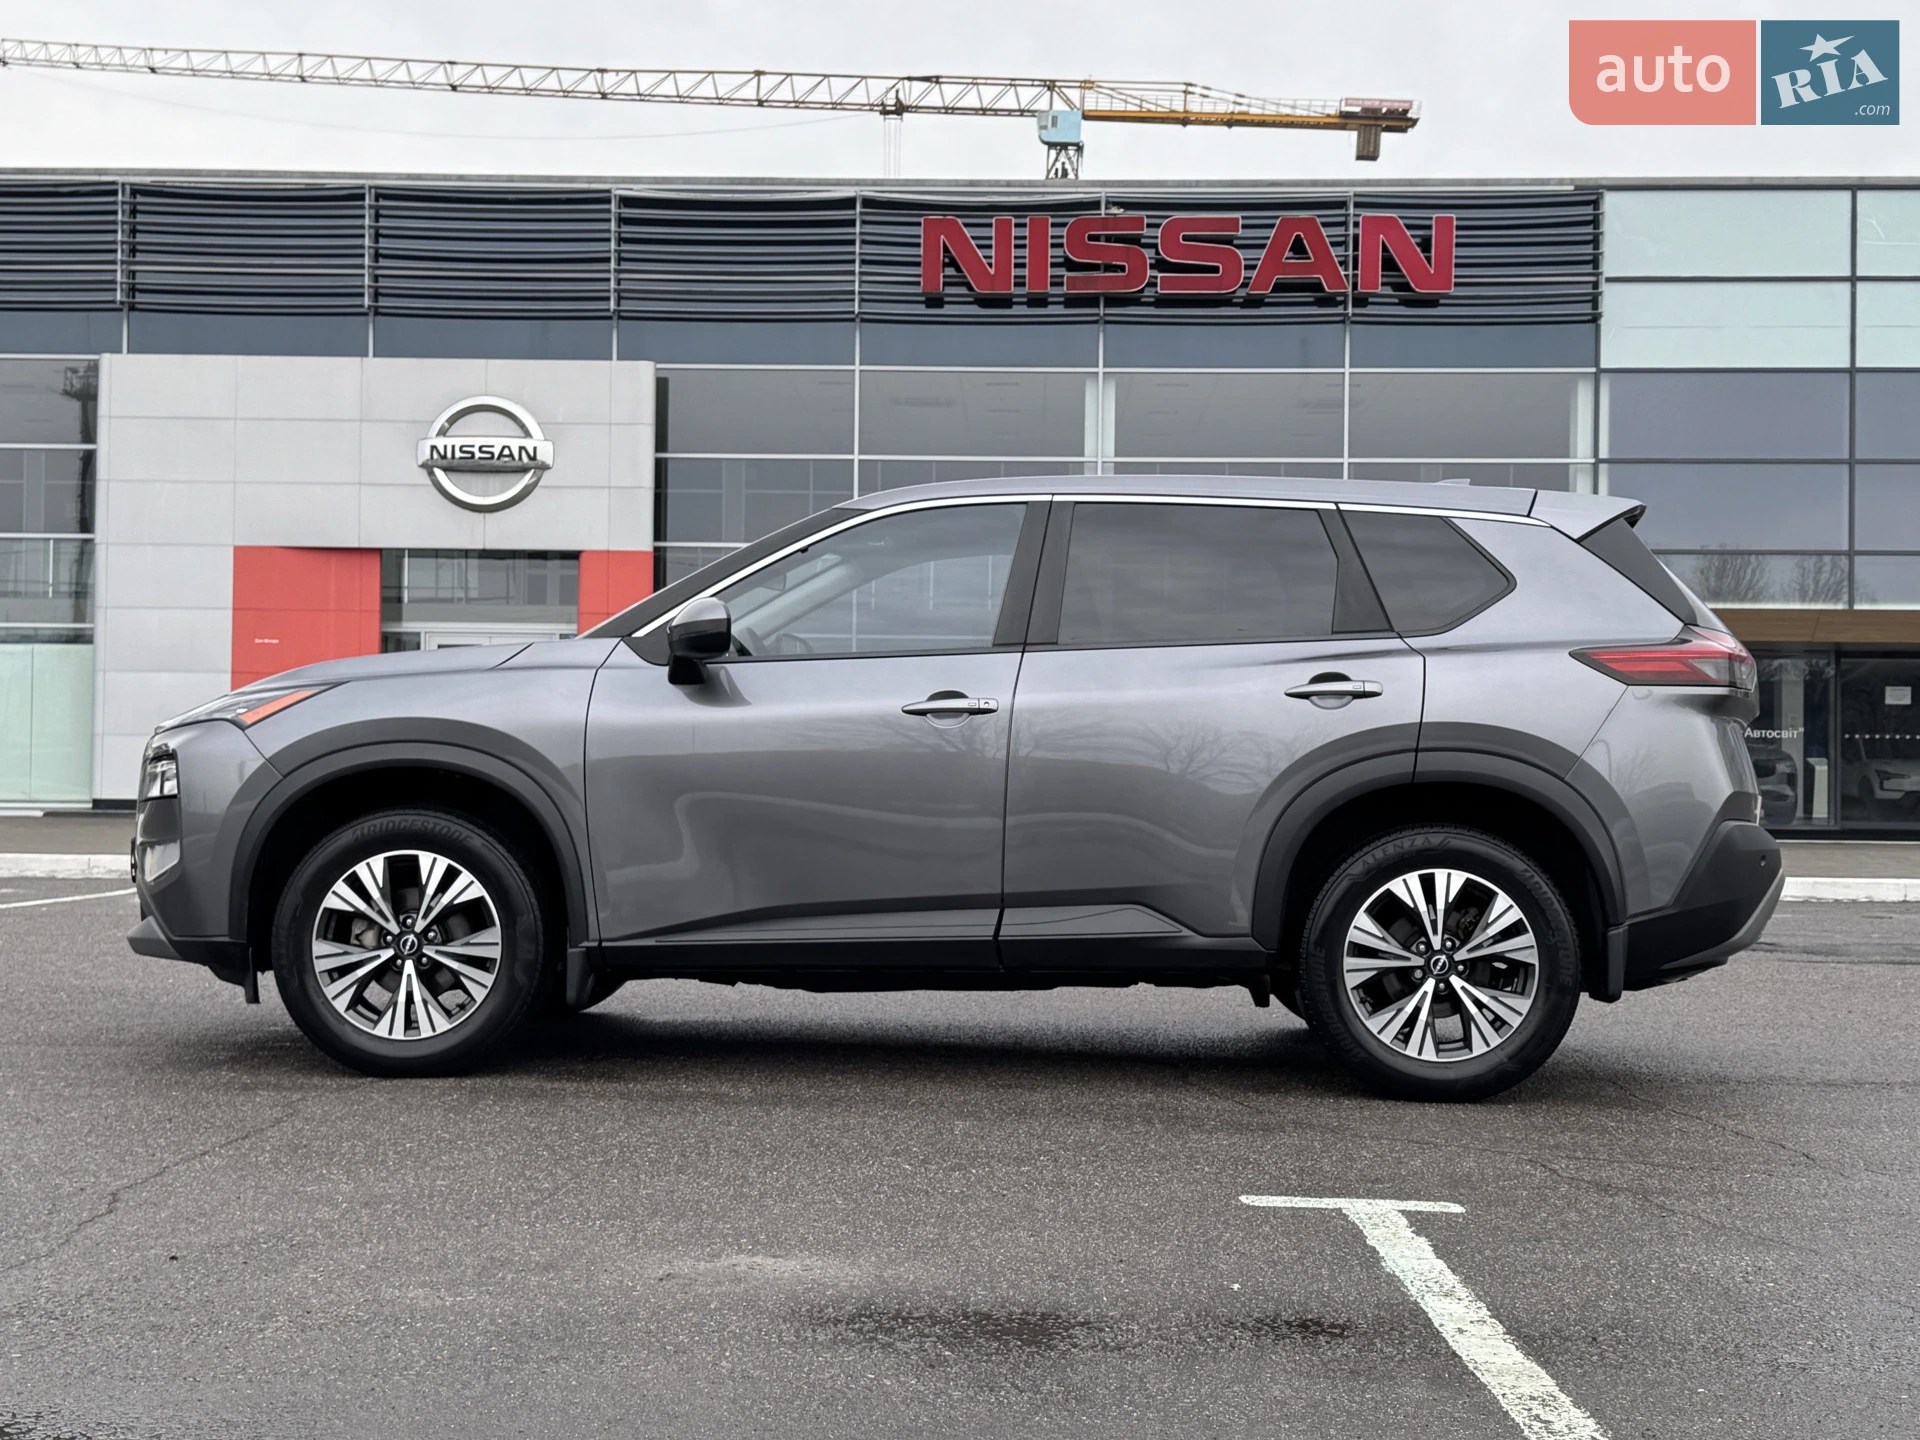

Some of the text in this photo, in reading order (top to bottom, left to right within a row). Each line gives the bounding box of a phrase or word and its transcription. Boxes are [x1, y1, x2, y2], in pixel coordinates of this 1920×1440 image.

[920, 214, 1456, 294] NISSAN
[430, 444, 538, 462] NISSAN
[1359, 835, 1433, 870] ALENZA
